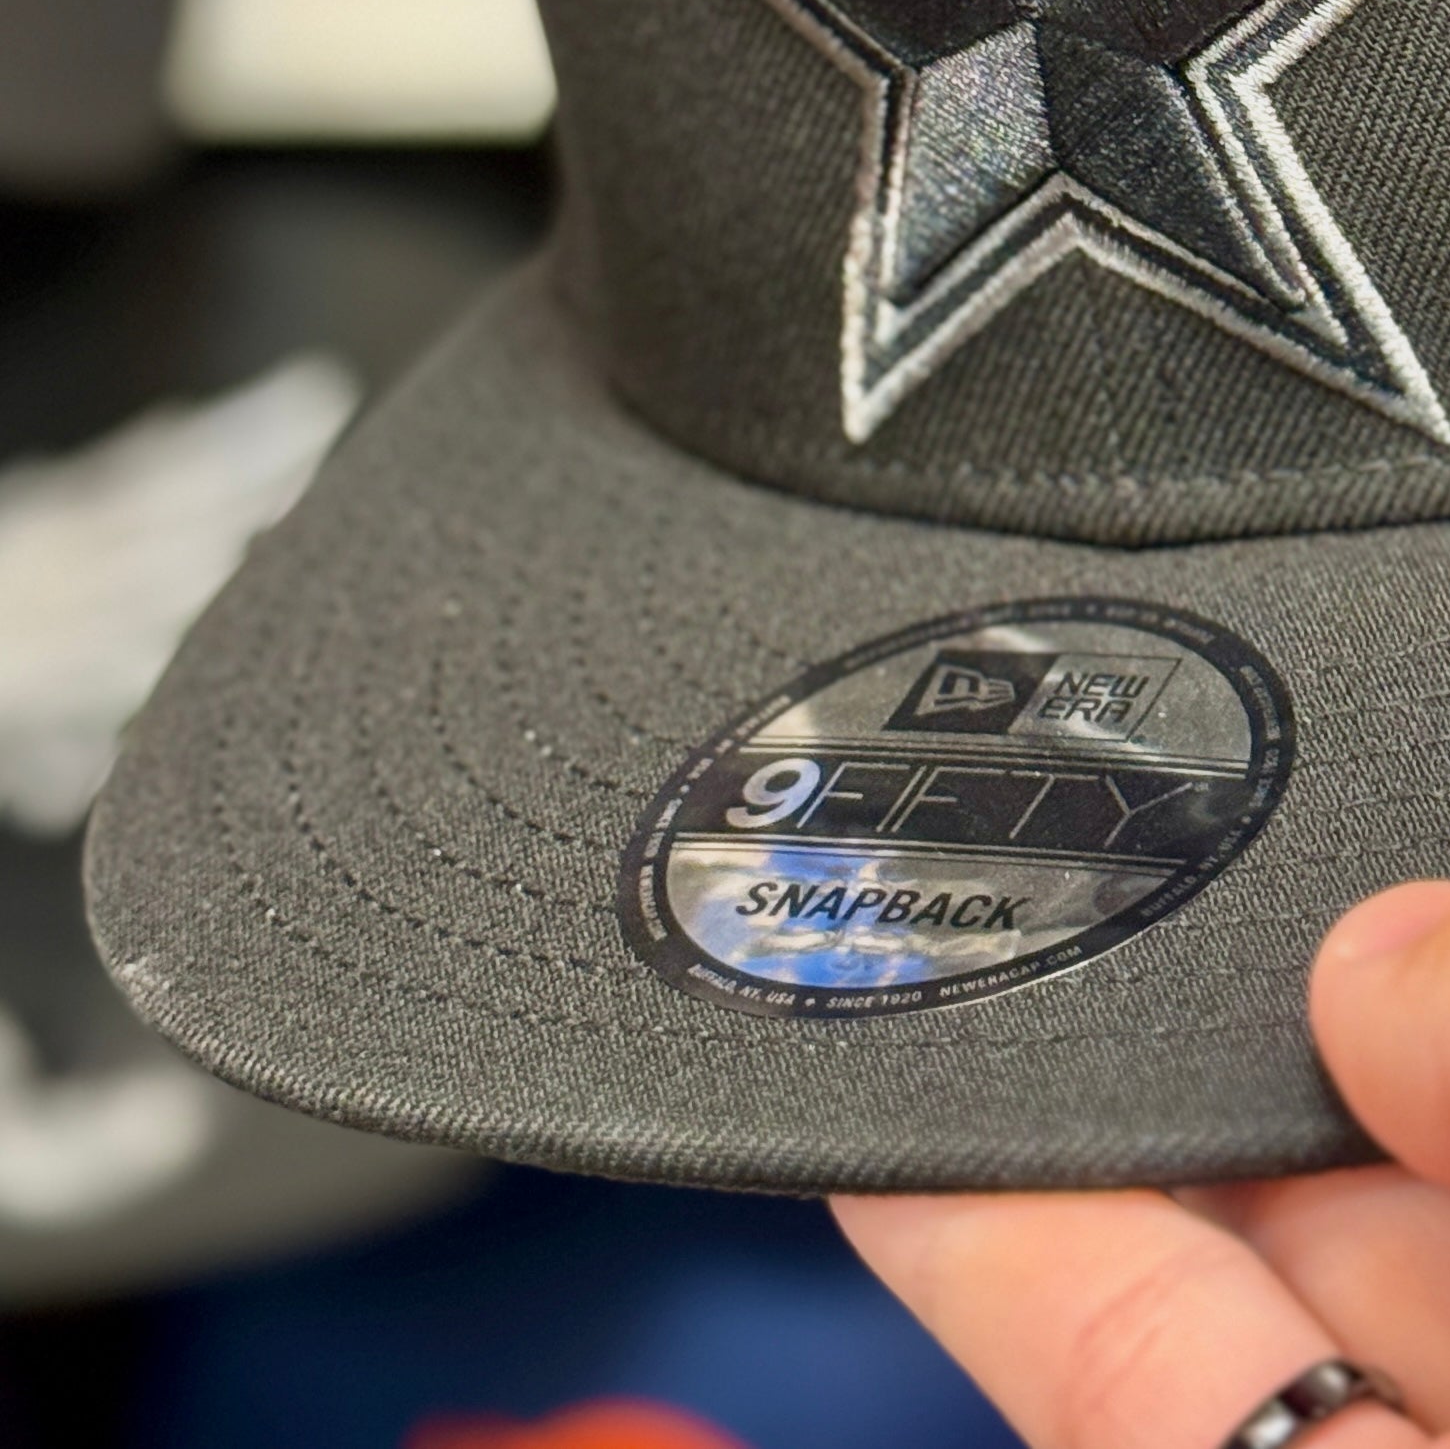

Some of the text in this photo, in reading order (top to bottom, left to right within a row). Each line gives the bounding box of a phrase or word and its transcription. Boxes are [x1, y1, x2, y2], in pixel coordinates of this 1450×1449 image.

[1054, 671, 1151, 699] NEW
[1037, 696, 1134, 724] ERA
[736, 881, 1031, 931] SNAPBACK
[765, 990, 796, 1006] USA
[825, 996, 875, 1009] SINCE
[882, 990, 923, 1007] 1920
